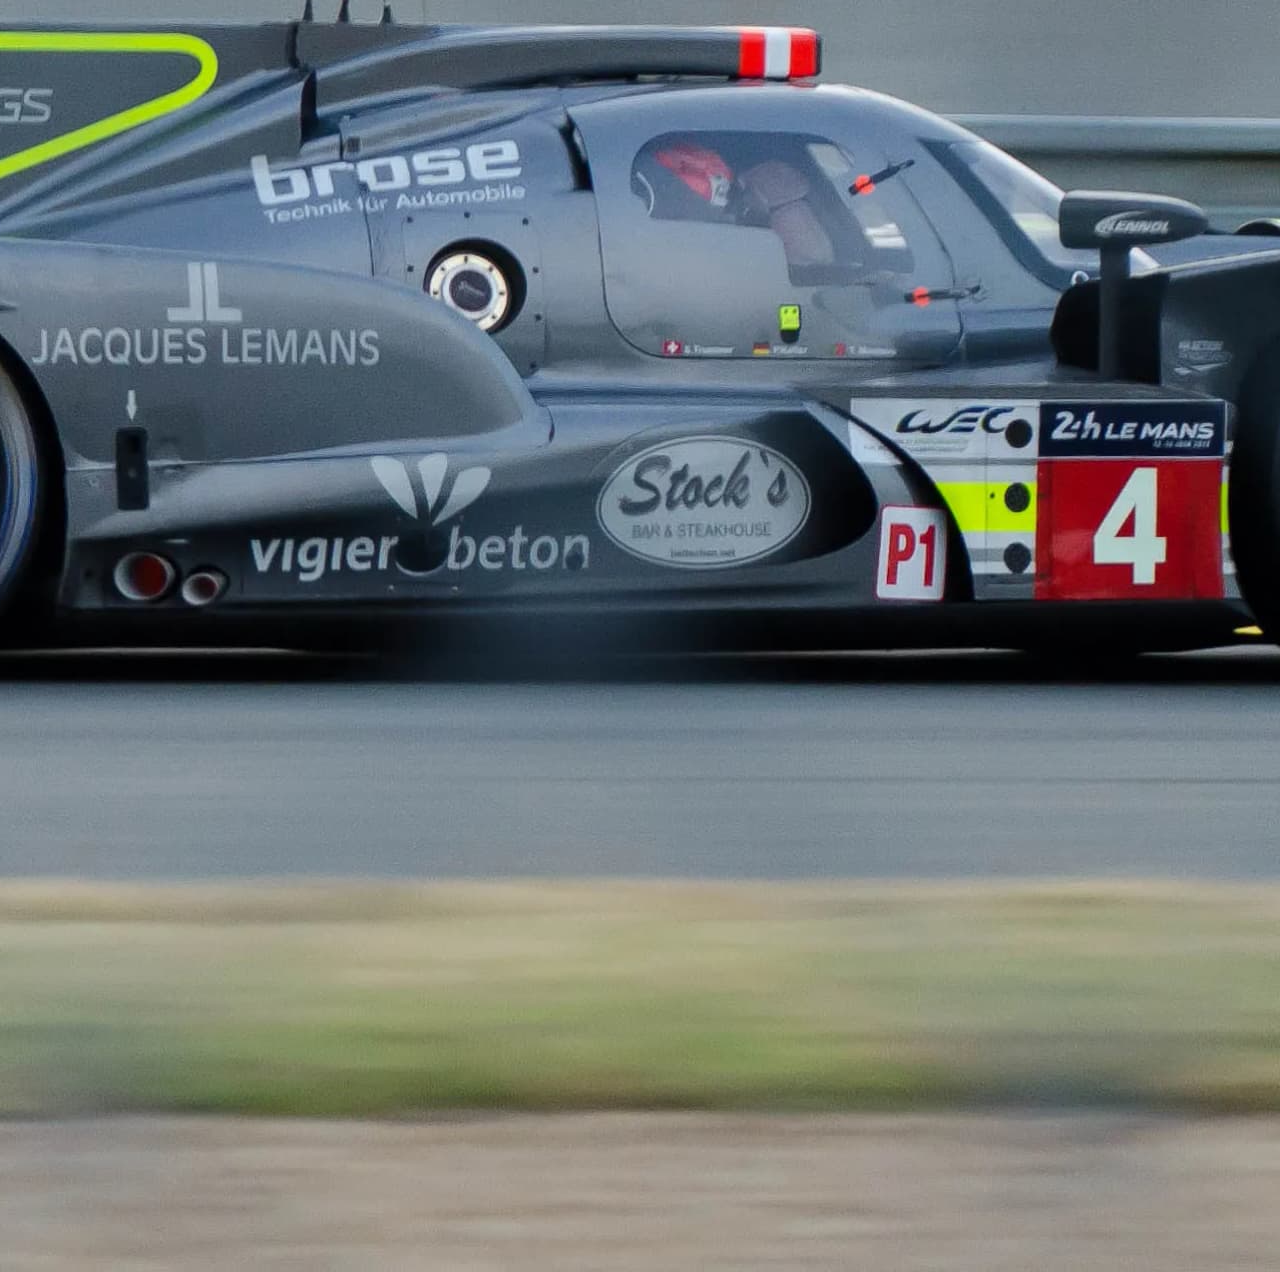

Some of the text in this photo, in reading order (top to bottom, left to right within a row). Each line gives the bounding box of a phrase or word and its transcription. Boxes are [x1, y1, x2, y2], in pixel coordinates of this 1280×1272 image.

[251, 140, 521, 205] brose
[264, 197, 352, 223] Technik
[396, 183, 526, 209] Automobile
[32, 327, 380, 365] JACQUES LEMANS
[896, 405, 1016, 433] WEC
[1104, 423, 1138, 440] LE
[1140, 423, 1214, 439] MANS
[677, 521, 772, 539] STEAKHOUSE
[1093, 467, 1167, 585] 4
[248, 525, 591, 581] vigier beton
[885, 522, 936, 587] P1
